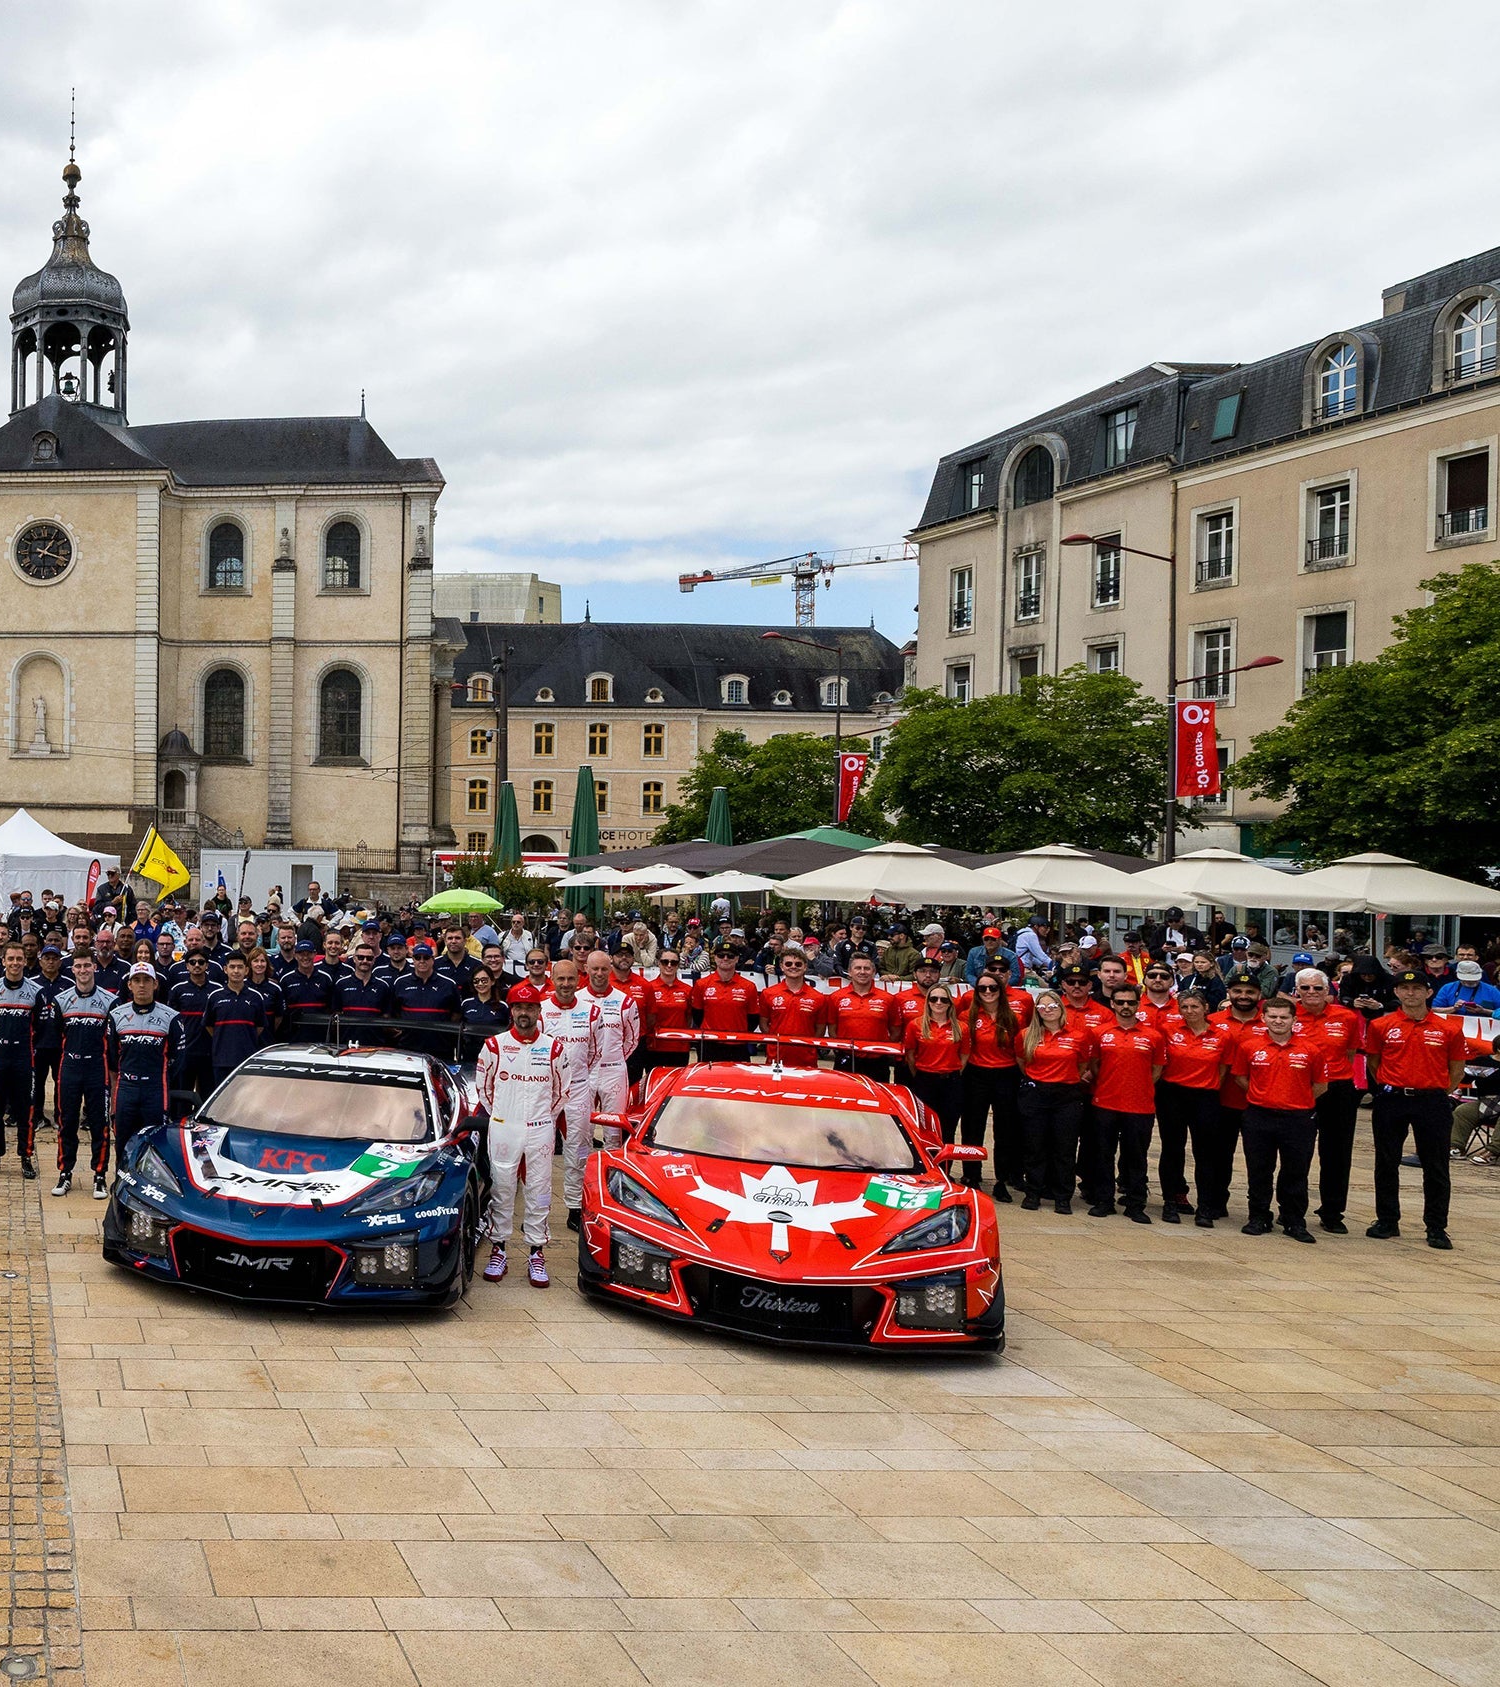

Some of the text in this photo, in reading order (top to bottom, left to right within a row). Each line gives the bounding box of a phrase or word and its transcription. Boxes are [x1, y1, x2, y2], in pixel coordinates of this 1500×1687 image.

[619, 831, 655, 840] HOTE
[66, 1017, 97, 1025] JMR
[120, 1035, 155, 1043] JMR
[555, 1035, 589, 1043] ORLANDO
[244, 1064, 422, 1083] CORVETTE
[511, 1074, 550, 1083] ORLANDO
[681, 1085, 880, 1107] CORVETTE
[258, 1148, 327, 1173] KFC
[370, 1161, 400, 1178] 2
[141, 1184, 167, 1203] XPEL
[882, 1189, 929, 1208] 13
[367, 1213, 406, 1227] XPEL
[415, 1206, 459, 1219] GOODYEAR
[215, 1252, 294, 1270] JMR
[740, 1286, 820, 1313] Thirteen
